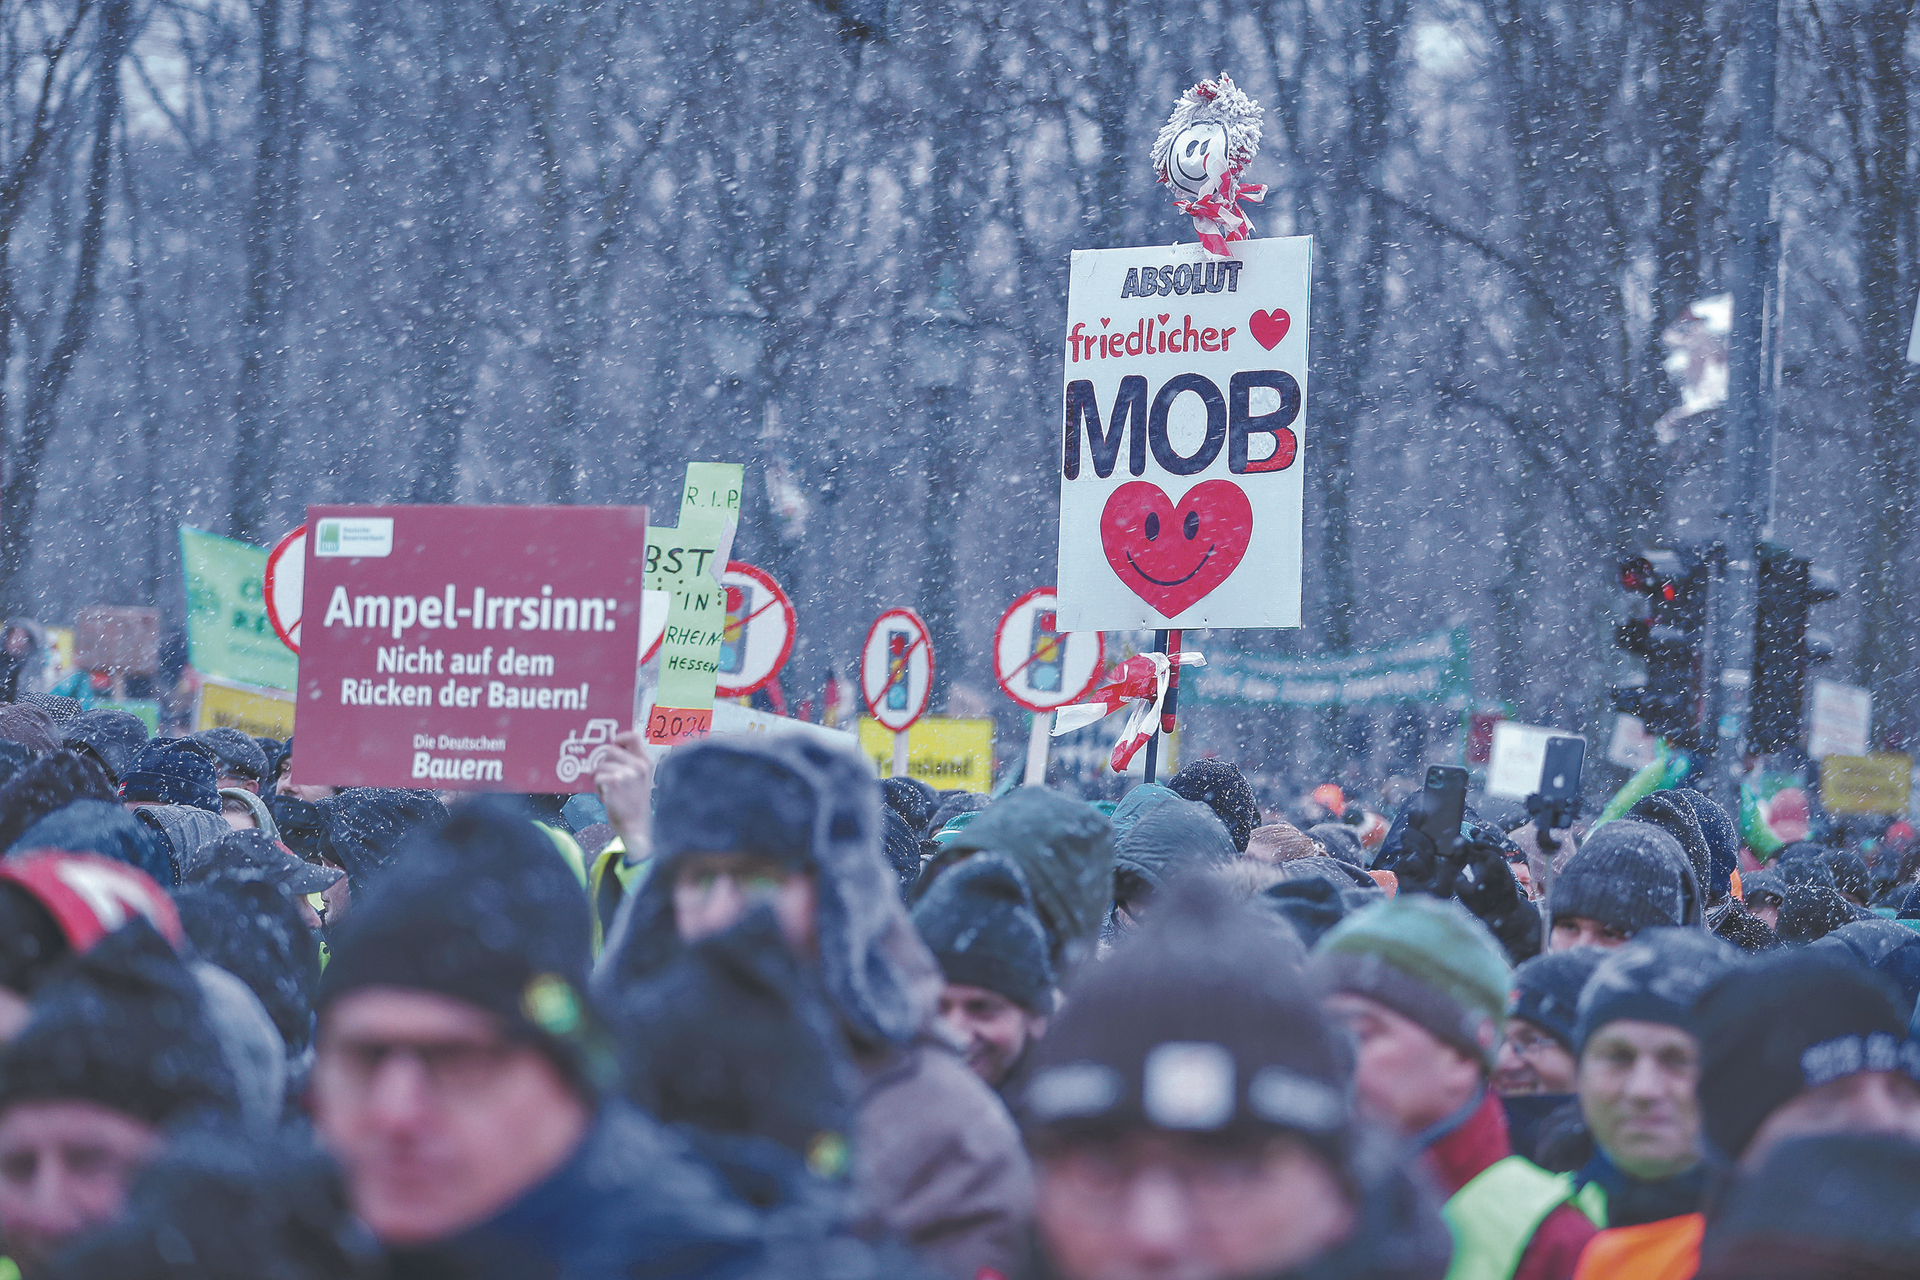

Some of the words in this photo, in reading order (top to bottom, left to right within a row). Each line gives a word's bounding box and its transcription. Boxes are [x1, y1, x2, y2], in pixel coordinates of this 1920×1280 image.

[1120, 261, 1243, 299] ABSOLUT
[1067, 313, 1236, 362] friedlicher
[1063, 369, 1302, 481] MOB
[322, 583, 617, 639] Ampel-Irrsinn:
[683, 592, 709, 611] IN
[376, 644, 445, 674] Nicht
[449, 645, 493, 675] auf
[497, 646, 554, 676] dem
[667, 655, 719, 673] HESSEN
[340, 676, 433, 708] Rücken
[438, 677, 483, 708] der
[487, 680, 589, 711] Bauern!
[412, 733, 436, 750] Die
[437, 734, 506, 752] Deutschen
[652, 715, 708, 739] 2024
[411, 751, 504, 782] Bauern
